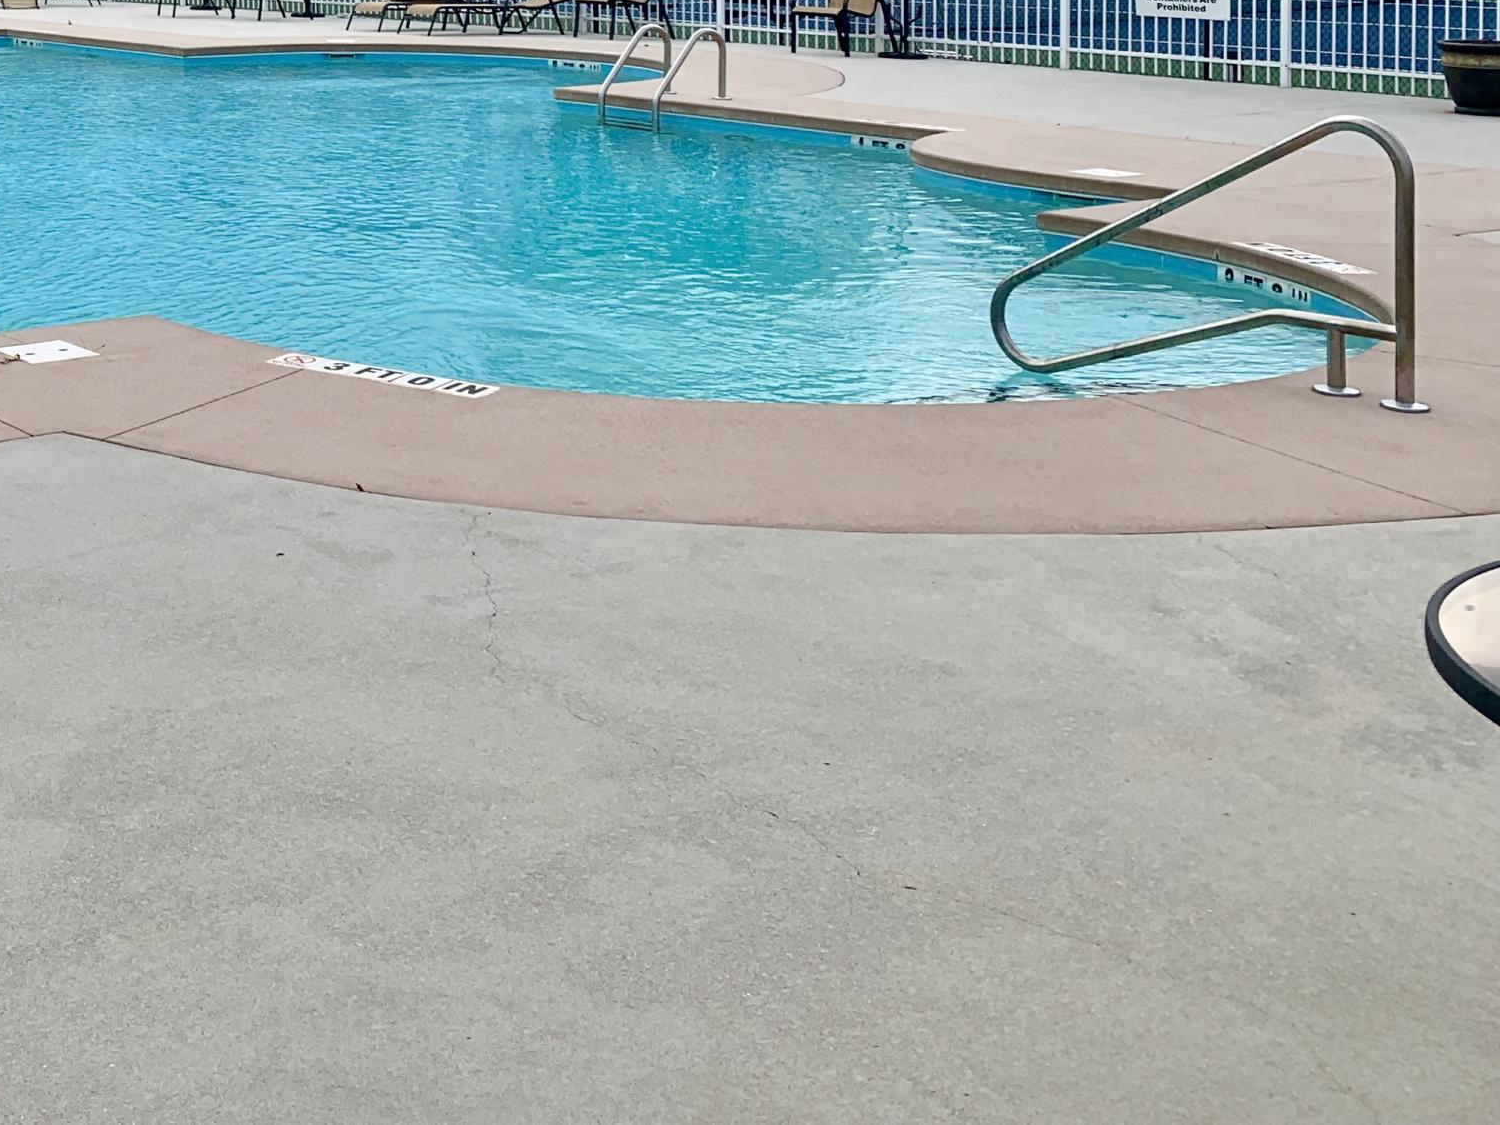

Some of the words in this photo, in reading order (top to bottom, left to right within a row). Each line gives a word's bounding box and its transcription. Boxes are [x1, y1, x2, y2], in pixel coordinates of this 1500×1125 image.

[1157, 3, 1206, 12] Prohibited
[324, 363, 350, 371] 3
[355, 367, 403, 378] FT
[407, 377, 435, 385] 0
[443, 382, 488, 395] IN
